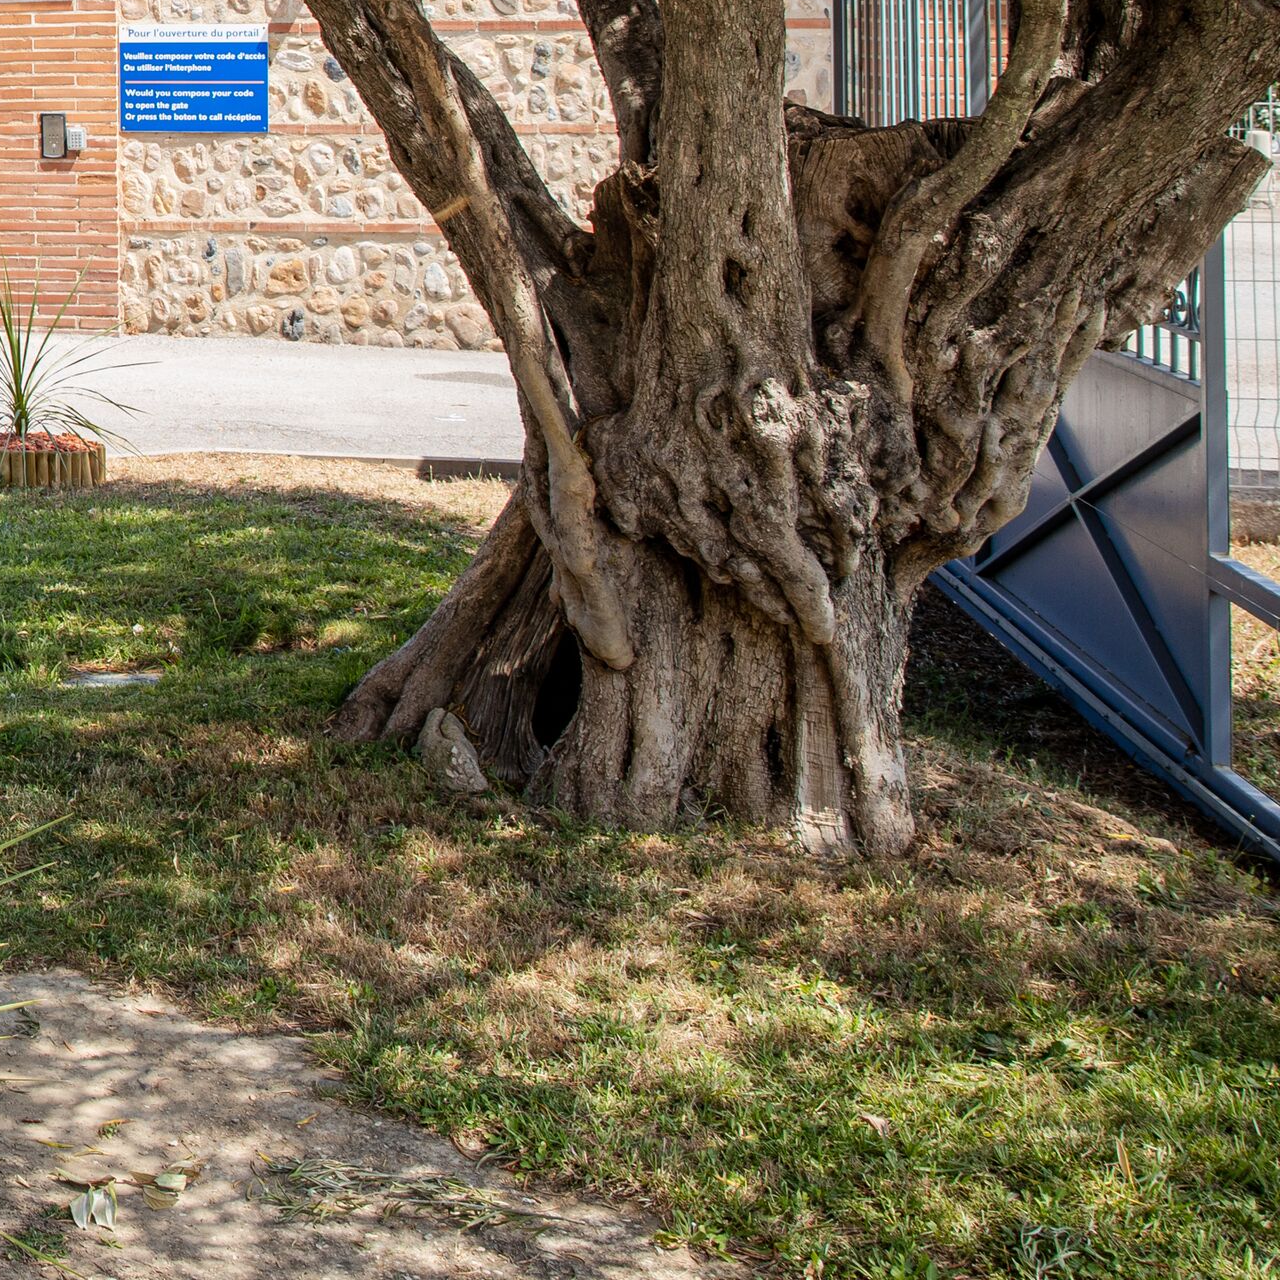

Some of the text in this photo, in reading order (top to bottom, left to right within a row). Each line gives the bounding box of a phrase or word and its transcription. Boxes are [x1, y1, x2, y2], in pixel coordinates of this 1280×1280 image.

[128, 29, 259, 38] Pour l'ouverture du portail
[123, 52, 153, 60] Veuillez
[155, 53, 192, 61] composer
[217, 52, 235, 60] code
[237, 52, 266, 60] d'accès
[165, 64, 211, 73] l'interphone
[125, 89, 153, 97] Would
[155, 90, 170, 98] you
[173, 90, 210, 98] compose
[212, 90, 231, 98] your
[171, 103, 188, 111] gate
[137, 114, 157, 122] press
